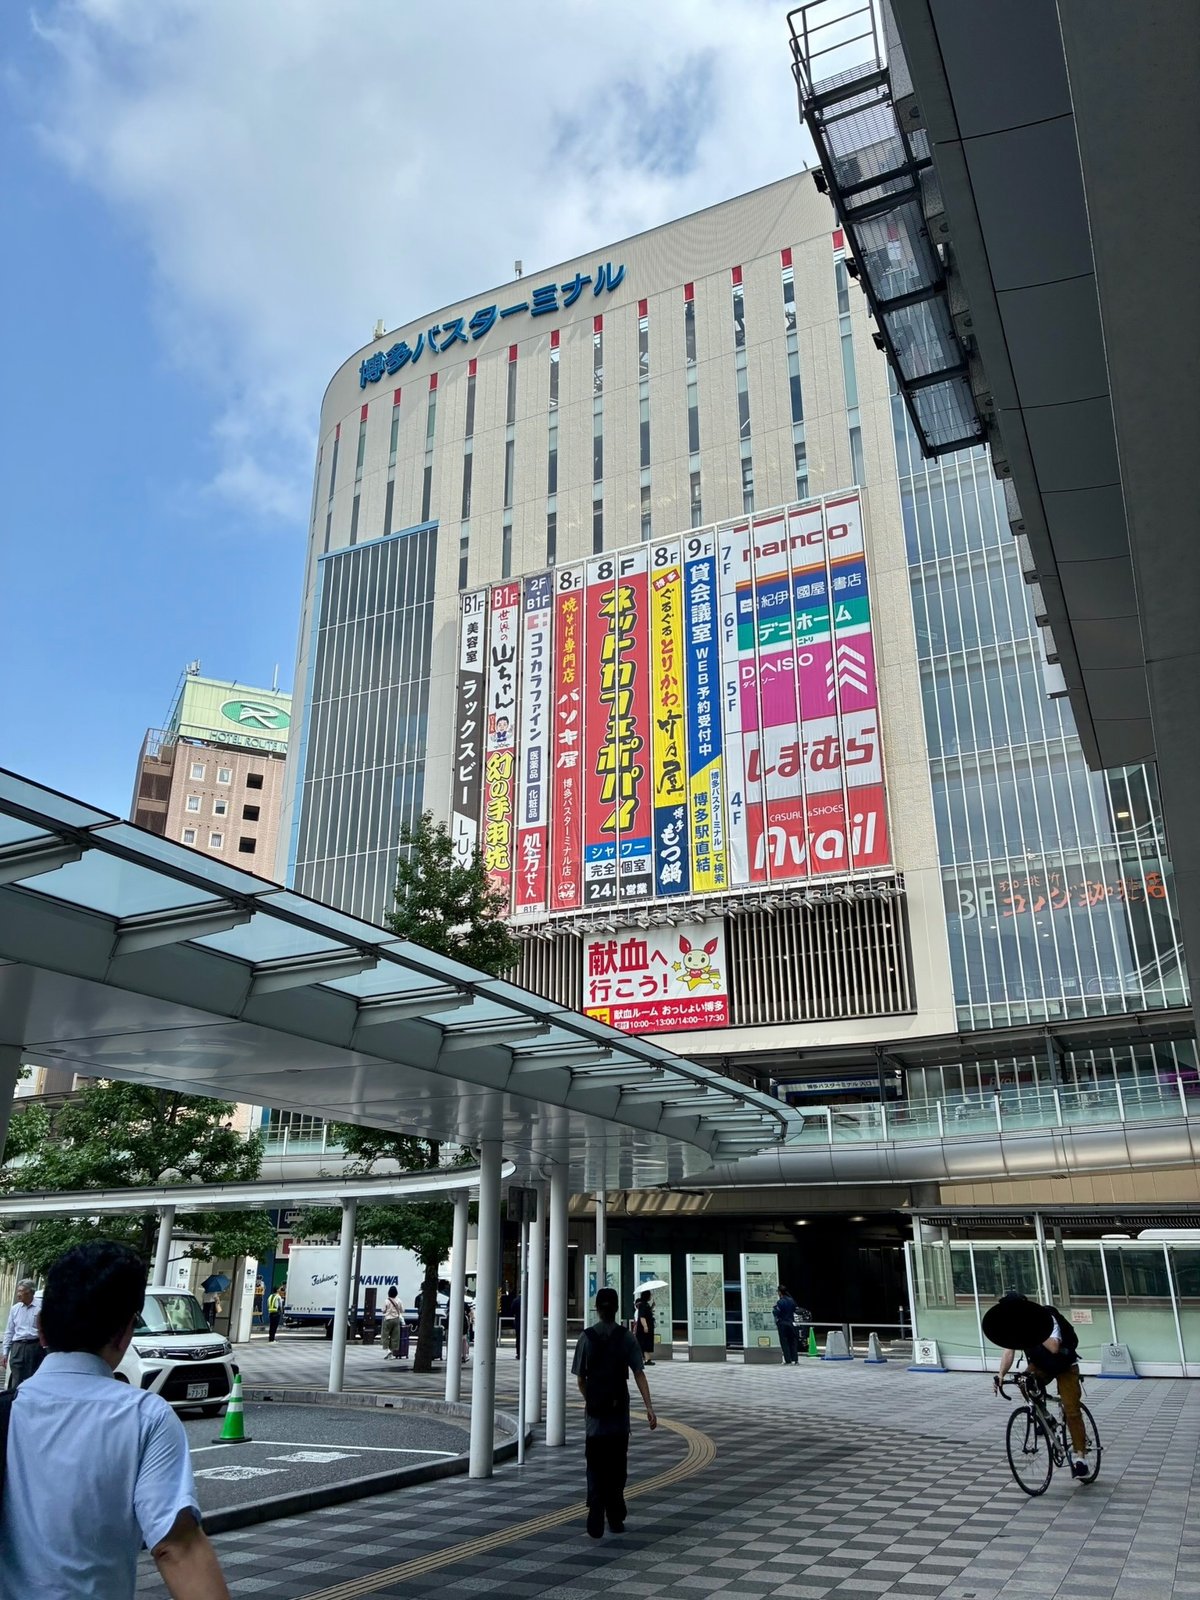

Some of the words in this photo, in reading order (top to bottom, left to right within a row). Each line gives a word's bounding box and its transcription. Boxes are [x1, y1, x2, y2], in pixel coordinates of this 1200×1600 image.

[358, 262, 626, 390] 博多バスターミナル
[654, 547, 678, 567] 8F
[688, 539, 712, 559] 9F
[742, 523, 849, 562] namco
[530, 577, 547, 591] 2F
[560, 571, 581, 590] 8F
[597, 558, 635, 580] 8F
[464, 594, 484, 615] B1F
[494, 587, 517, 608] B1F
[527, 595, 550, 610] B1F
[690, 563, 712, 644] 貸会議室
[761, 573, 862, 608] 紀伊國屋書店
[759, 604, 853, 641] デコホーム
[465, 622, 479, 664] 美容室
[562, 597, 579, 684] 焼そば専門店
[798, 636, 814, 645] ニトリ
[492, 643, 515, 710] 山ちゃん
[742, 653, 814, 680] DAISO
[529, 632, 543, 741] ココカラファイン
[743, 677, 776, 689] ダイソー
[210, 731, 241, 745] HOTEL
[245, 738, 277, 751] ROUTE
[458, 679, 477, 804] ラックスビー
[747, 727, 875, 783] しまむら
[529, 750, 539, 779] 医薬品
[486, 751, 513, 872] 幻の手羽先
[528, 789, 538, 819] 化粧品
[711, 771, 722, 846] 博多バスターミナル
[770, 811, 803, 823] CASUAL
[562, 778, 573, 876] 博多バスターミナル店
[694, 792, 711, 873] 博多駅直結
[754, 812, 877, 870] Avail
[523, 832, 542, 898] 処方せん
[591, 843, 646, 859] シャワー
[660, 823, 682, 886] もつ鍋
[591, 859, 646, 878] 完全個室
[714, 853, 725, 884] で検索
[590, 882, 648, 899] 24h営業
[958, 887, 996, 920] 3F
[588, 937, 668, 977] 献血へ
[613, 1006, 659, 1020] 献血ルーム
[662, 1001, 724, 1016] おっしょい博多
[360, 1275, 399, 1286] NANIWA
